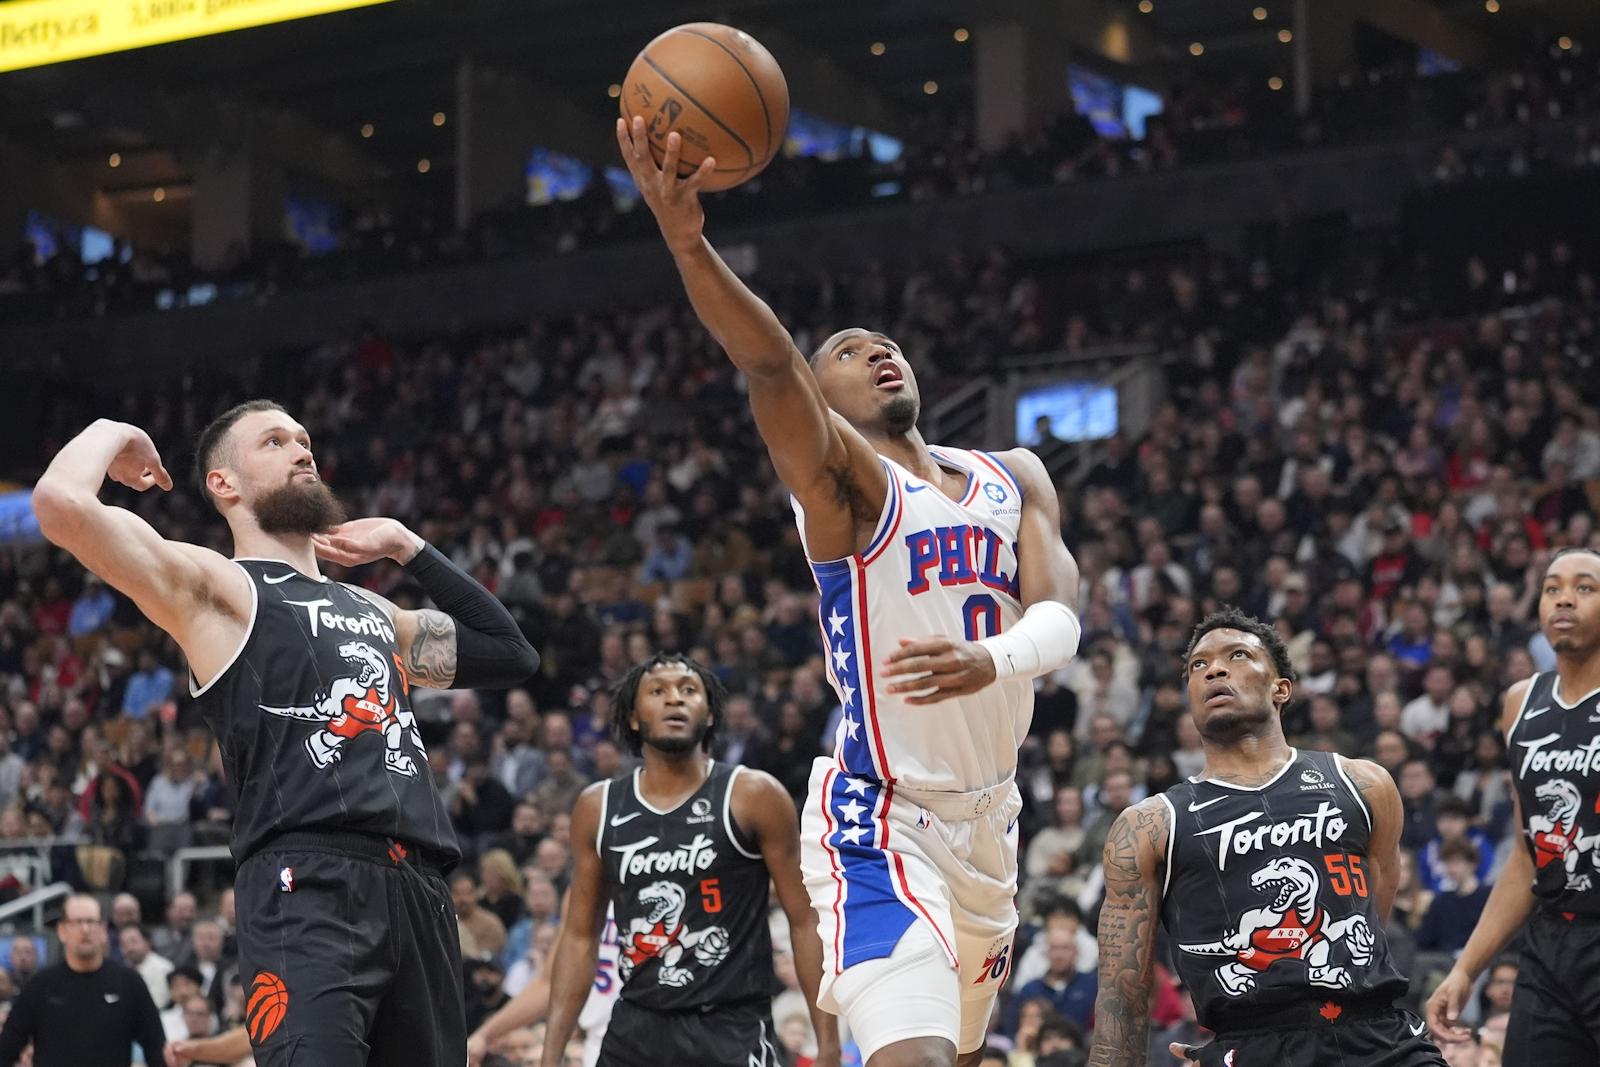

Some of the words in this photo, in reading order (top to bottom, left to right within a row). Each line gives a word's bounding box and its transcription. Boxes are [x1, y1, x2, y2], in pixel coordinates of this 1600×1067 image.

[282, 599, 395, 644] Toronto
[1300, 783, 1319, 791] Sun
[1318, 782, 1336, 790] Life
[1193, 801, 1348, 871] Toronto
[609, 833, 717, 884] Toronto
[1324, 854, 1368, 898] 55
[700, 878, 722, 913] 5
